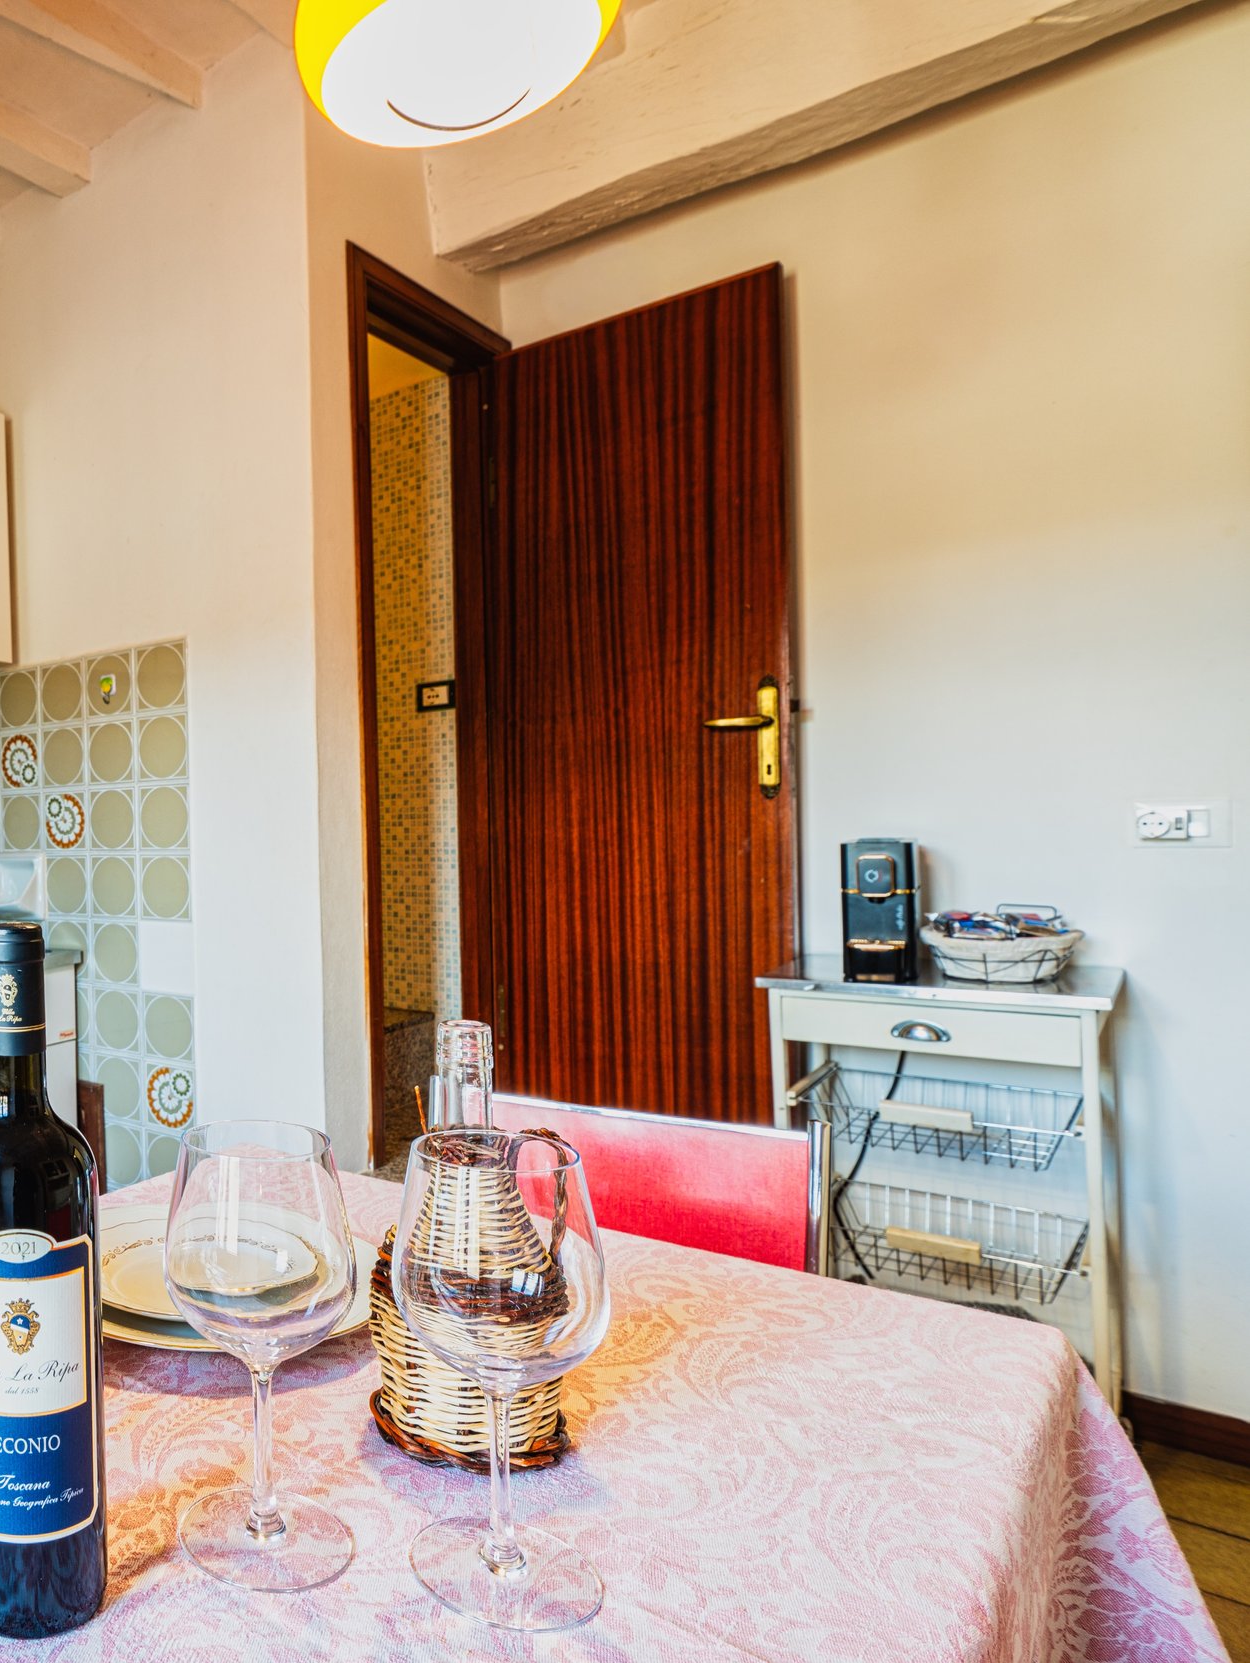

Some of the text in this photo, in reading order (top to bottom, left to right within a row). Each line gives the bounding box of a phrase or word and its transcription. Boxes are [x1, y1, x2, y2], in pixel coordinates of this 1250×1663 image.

[1, 1241, 36, 1256] 2021
[5, 1363, 33, 1382] La
[38, 1360, 79, 1383] Ripa
[12, 1496, 58, 1510] Geografica
[60, 1488, 84, 1502] Tipica
